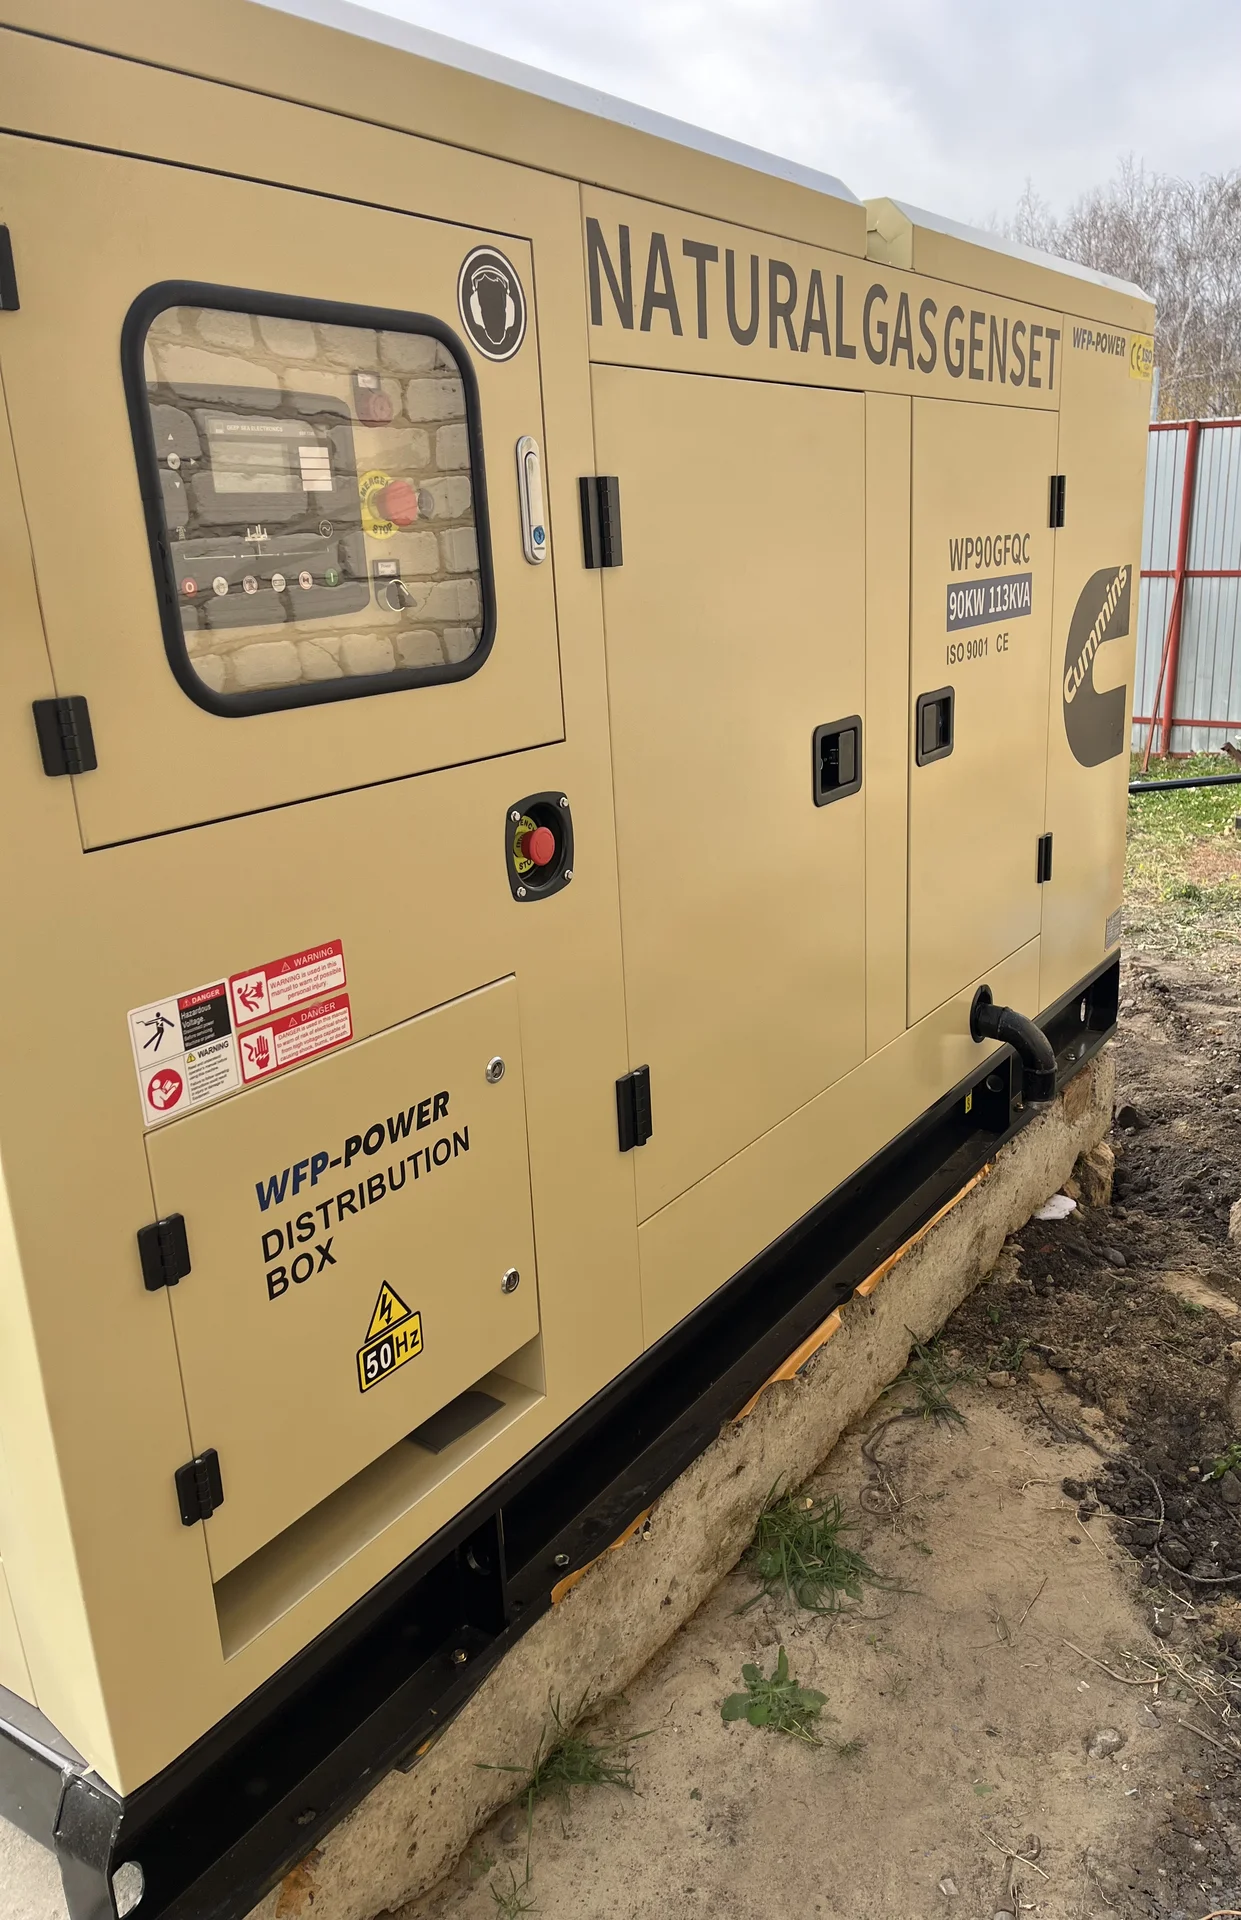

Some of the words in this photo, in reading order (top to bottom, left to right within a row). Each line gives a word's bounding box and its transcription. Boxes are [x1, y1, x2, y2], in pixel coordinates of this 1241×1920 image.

[586, 216, 856, 360] NATURAL
[862, 283, 938, 374] GAS
[944, 305, 1061, 390] GENSET
[1073, 326, 1126, 357] WFP-POWER
[373, 522, 392, 534] STOP
[949, 532, 1030, 572] WP90GFQC
[950, 588, 985, 621] 90KW
[988, 581, 1030, 614] 113KVA
[1064, 565, 1127, 704] Cummins
[946, 642, 964, 666] ISO
[966, 637, 988, 660] 9001
[996, 632, 1009, 653] CE
[519, 860, 531, 870] STO
[293, 947, 334, 967] WARNING
[270, 974, 300, 989] WARNING
[307, 967, 320, 976] used
[327, 961, 337, 969] this
[271, 986, 292, 997] manual
[320, 968, 342, 981] possible
[192, 989, 220, 1004] DANGER
[288, 986, 311, 1000] personal
[181, 1004, 211, 1020] Hazardous
[301, 1002, 336, 1022] DANGER
[278, 1027, 300, 1040] DANGER
[306, 1021, 317, 1029] used
[314, 1022, 334, 1033] electrical
[335, 1016, 348, 1024] shock
[198, 1040, 229, 1058] WARNING
[280, 1050, 299, 1062] causing
[255, 1090, 450, 1212] WFP-POWER
[261, 1126, 471, 1264] DISTRIBUTION
[266, 1236, 337, 1302] BOX
